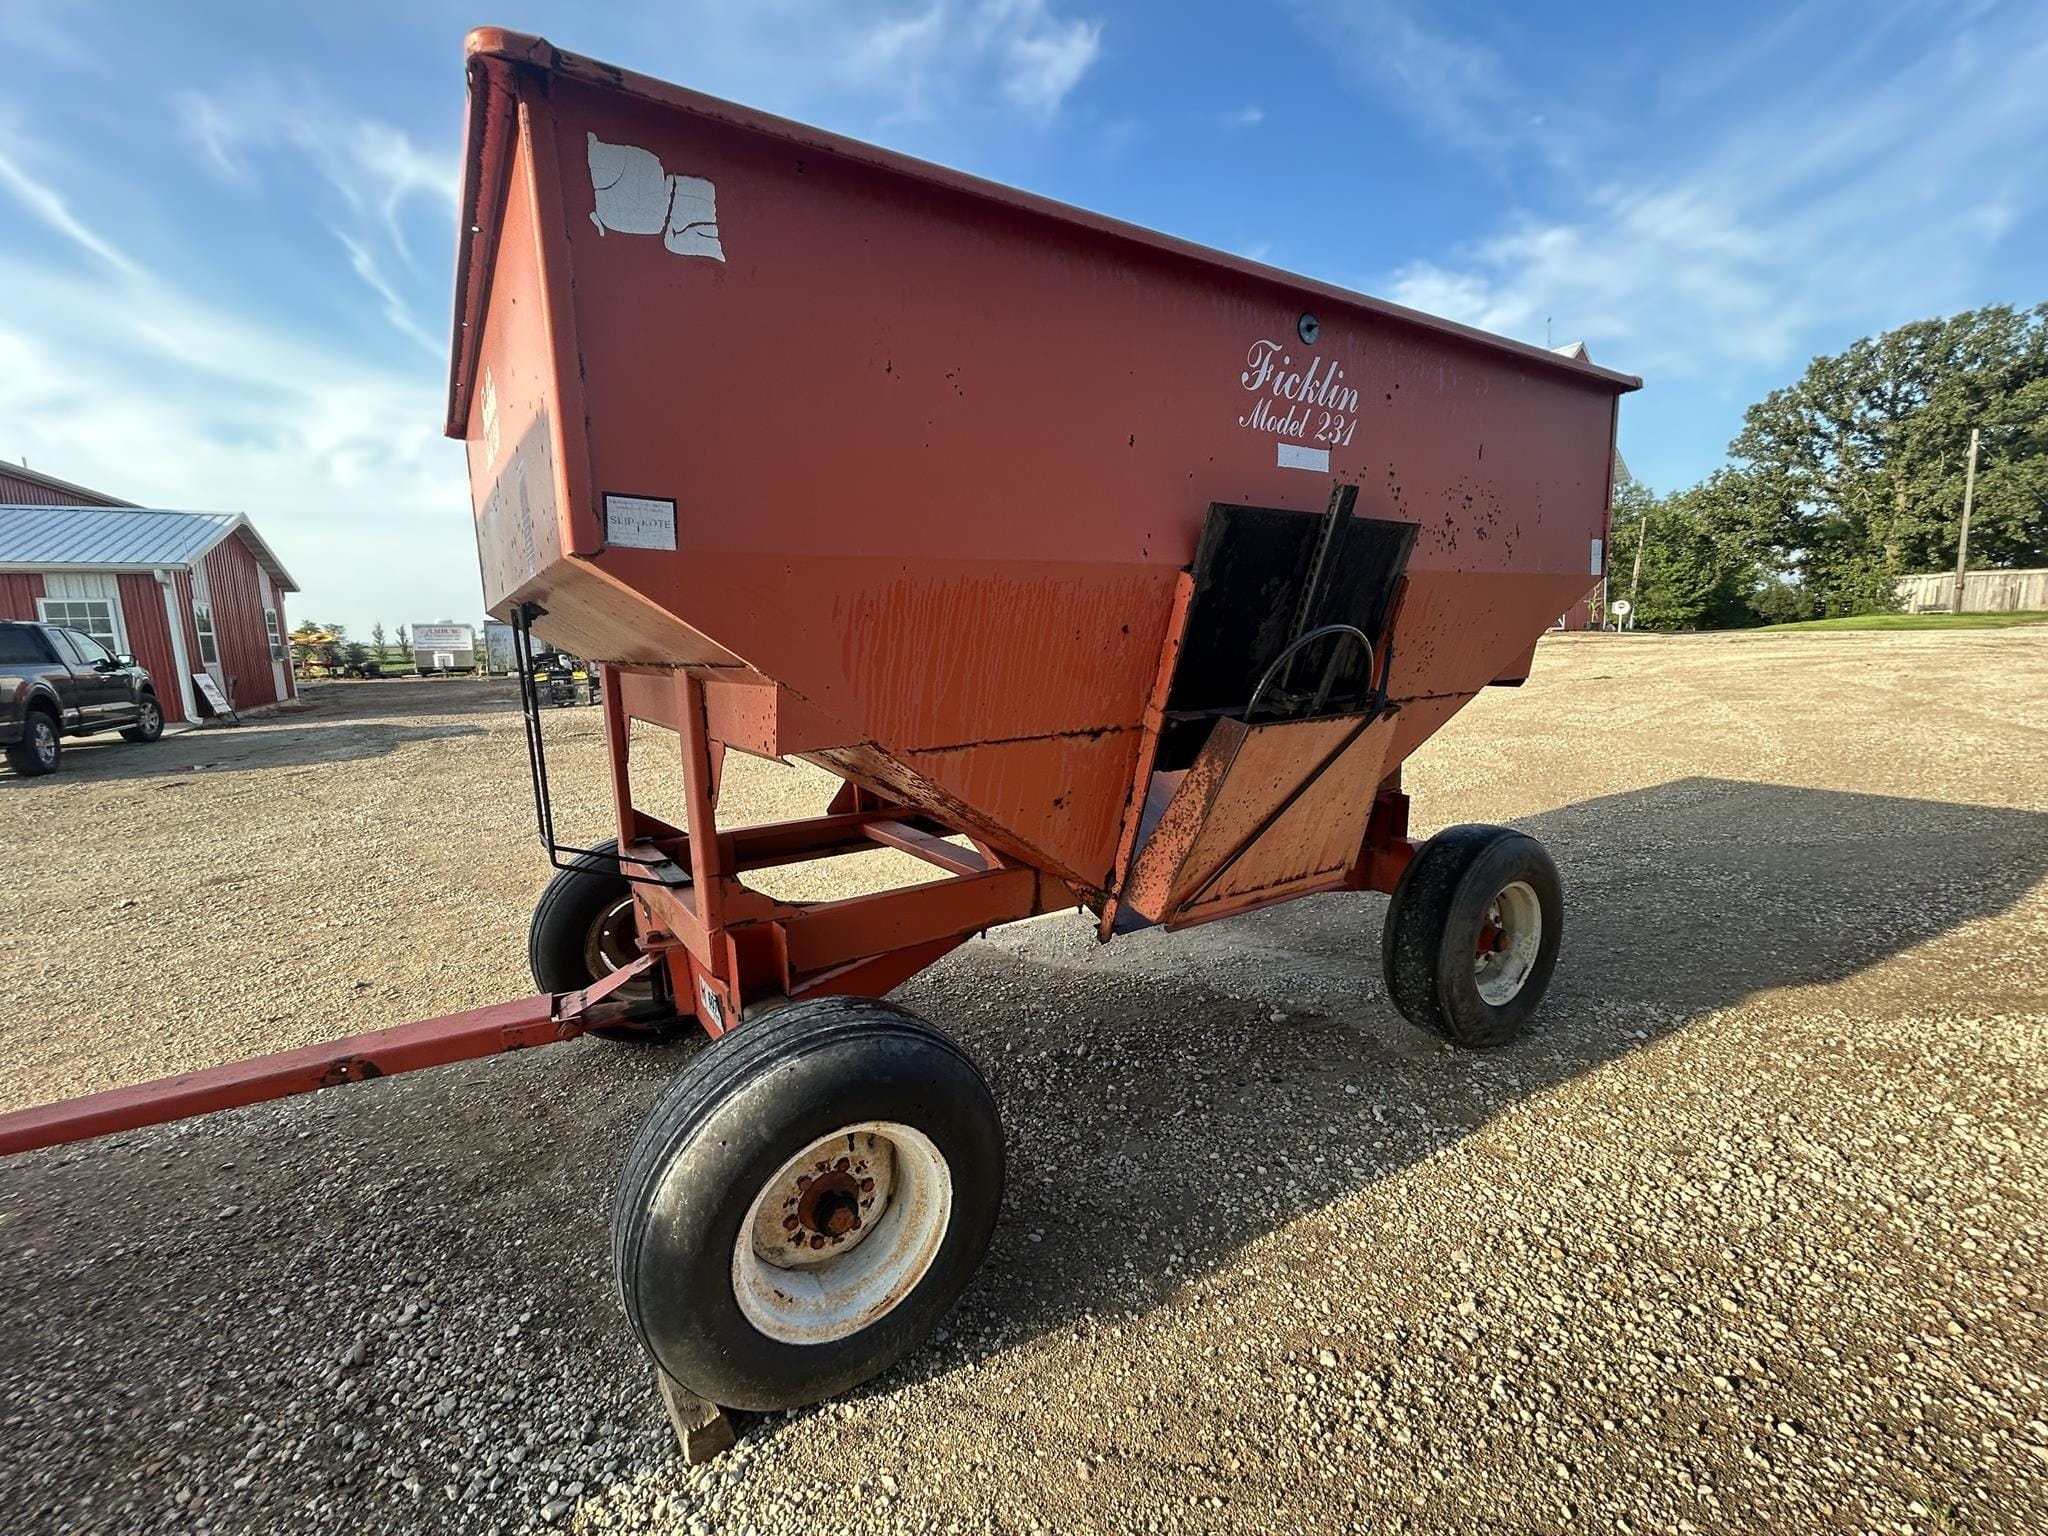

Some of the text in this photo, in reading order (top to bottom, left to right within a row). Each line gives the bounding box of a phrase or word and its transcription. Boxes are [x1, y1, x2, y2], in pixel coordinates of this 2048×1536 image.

[1241, 339, 1360, 414] Ficklin
[1238, 397, 1358, 446] Model 231
